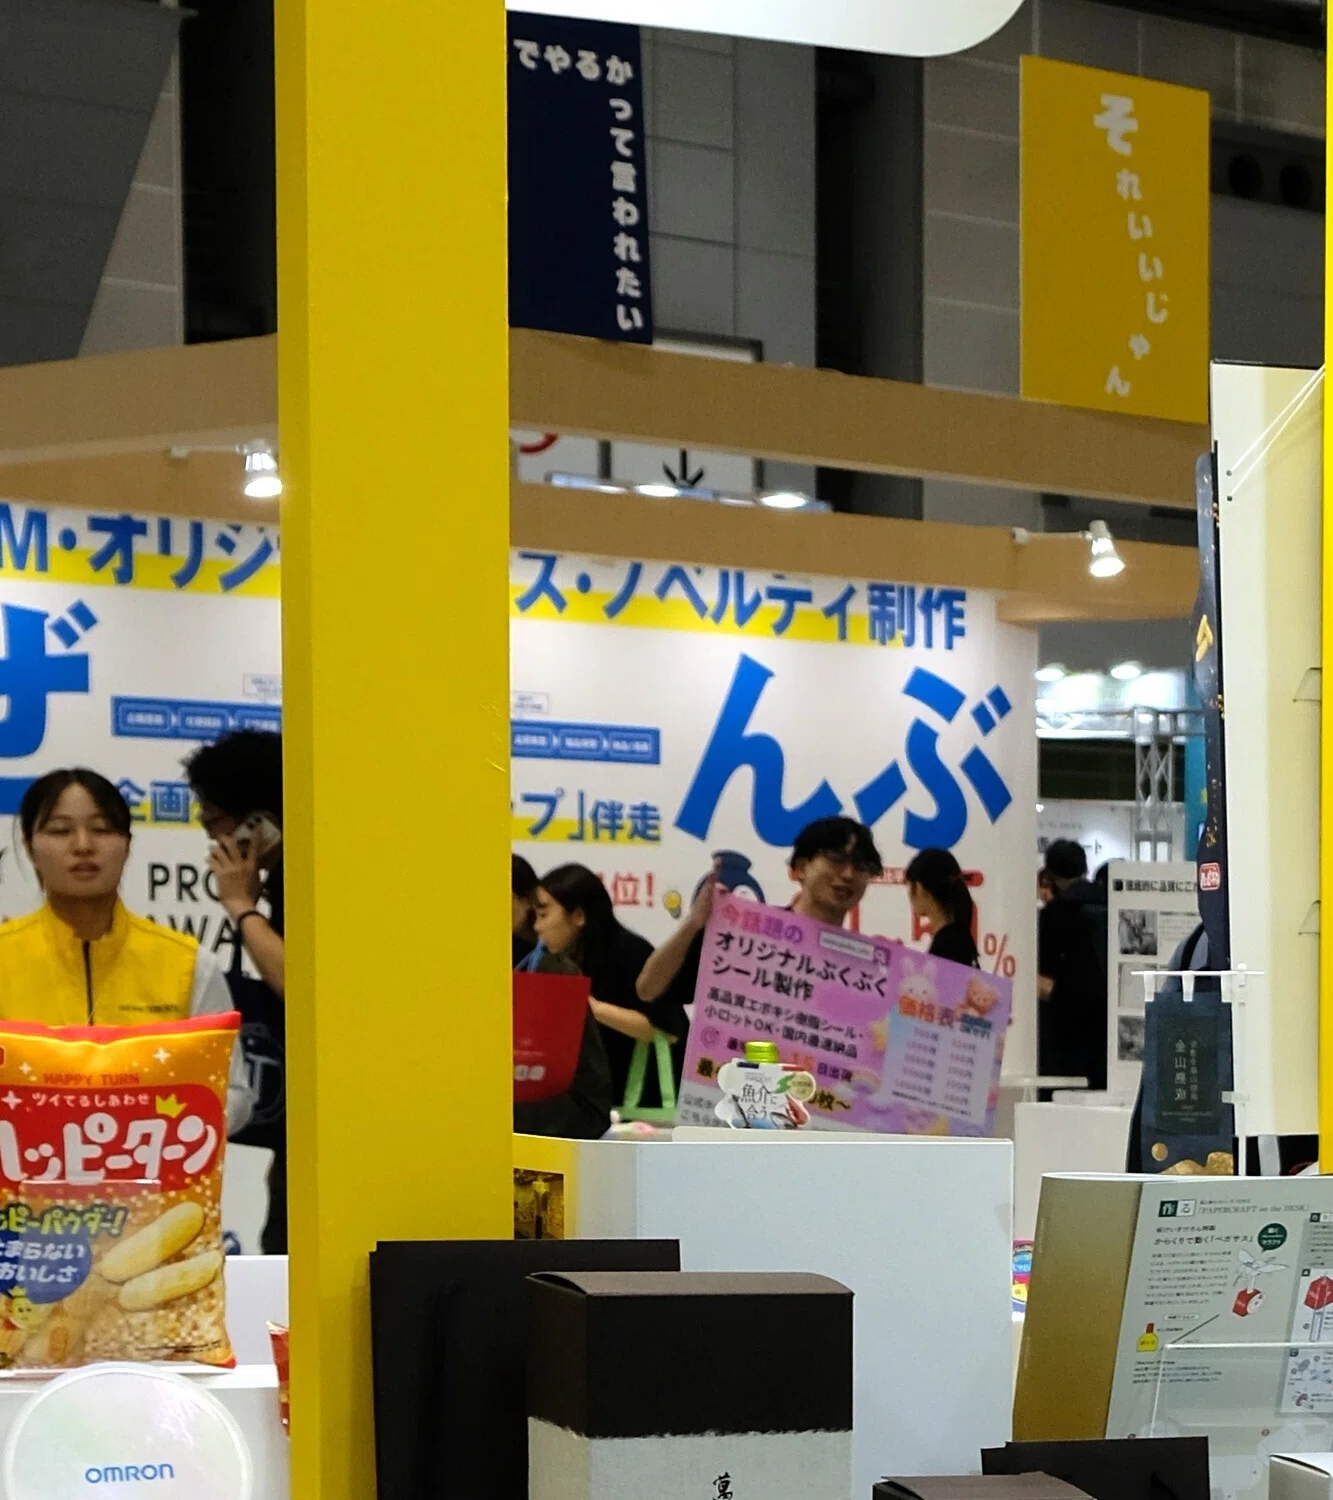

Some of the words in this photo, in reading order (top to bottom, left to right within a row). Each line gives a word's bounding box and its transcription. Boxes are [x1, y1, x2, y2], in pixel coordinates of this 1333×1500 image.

[1093, 93, 1169, 397] それいいじゃん
[43, 1072, 91, 1086] HAPPY
[100, 1071, 141, 1086] TURN
